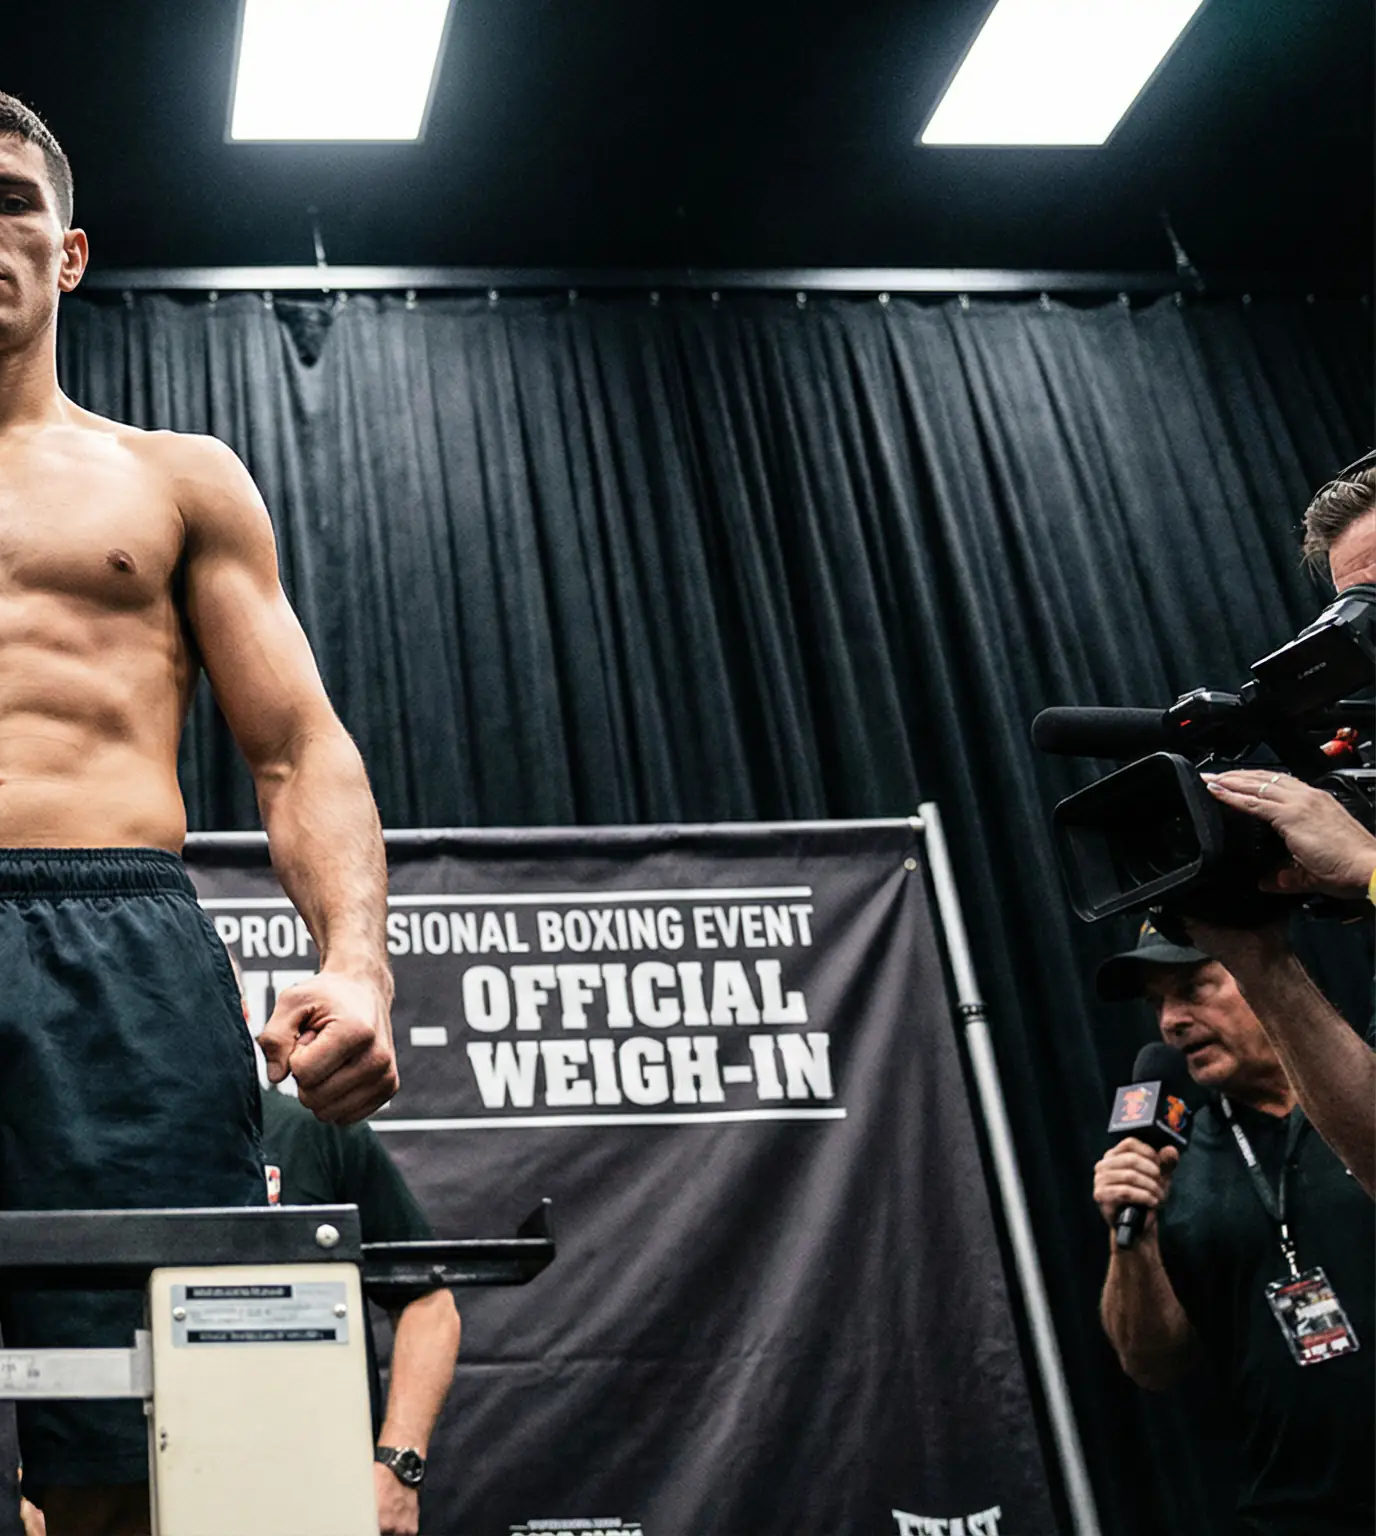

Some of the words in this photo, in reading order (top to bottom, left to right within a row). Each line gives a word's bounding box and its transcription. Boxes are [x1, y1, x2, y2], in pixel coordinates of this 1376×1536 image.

[214, 910, 530, 958] PROFSIONAL
[536, 906, 686, 953] BOXING
[691, 904, 814, 949] EVENT
[462, 959, 809, 1033] OFFICIAL
[466, 1032, 834, 1109] WEIGH-IN
